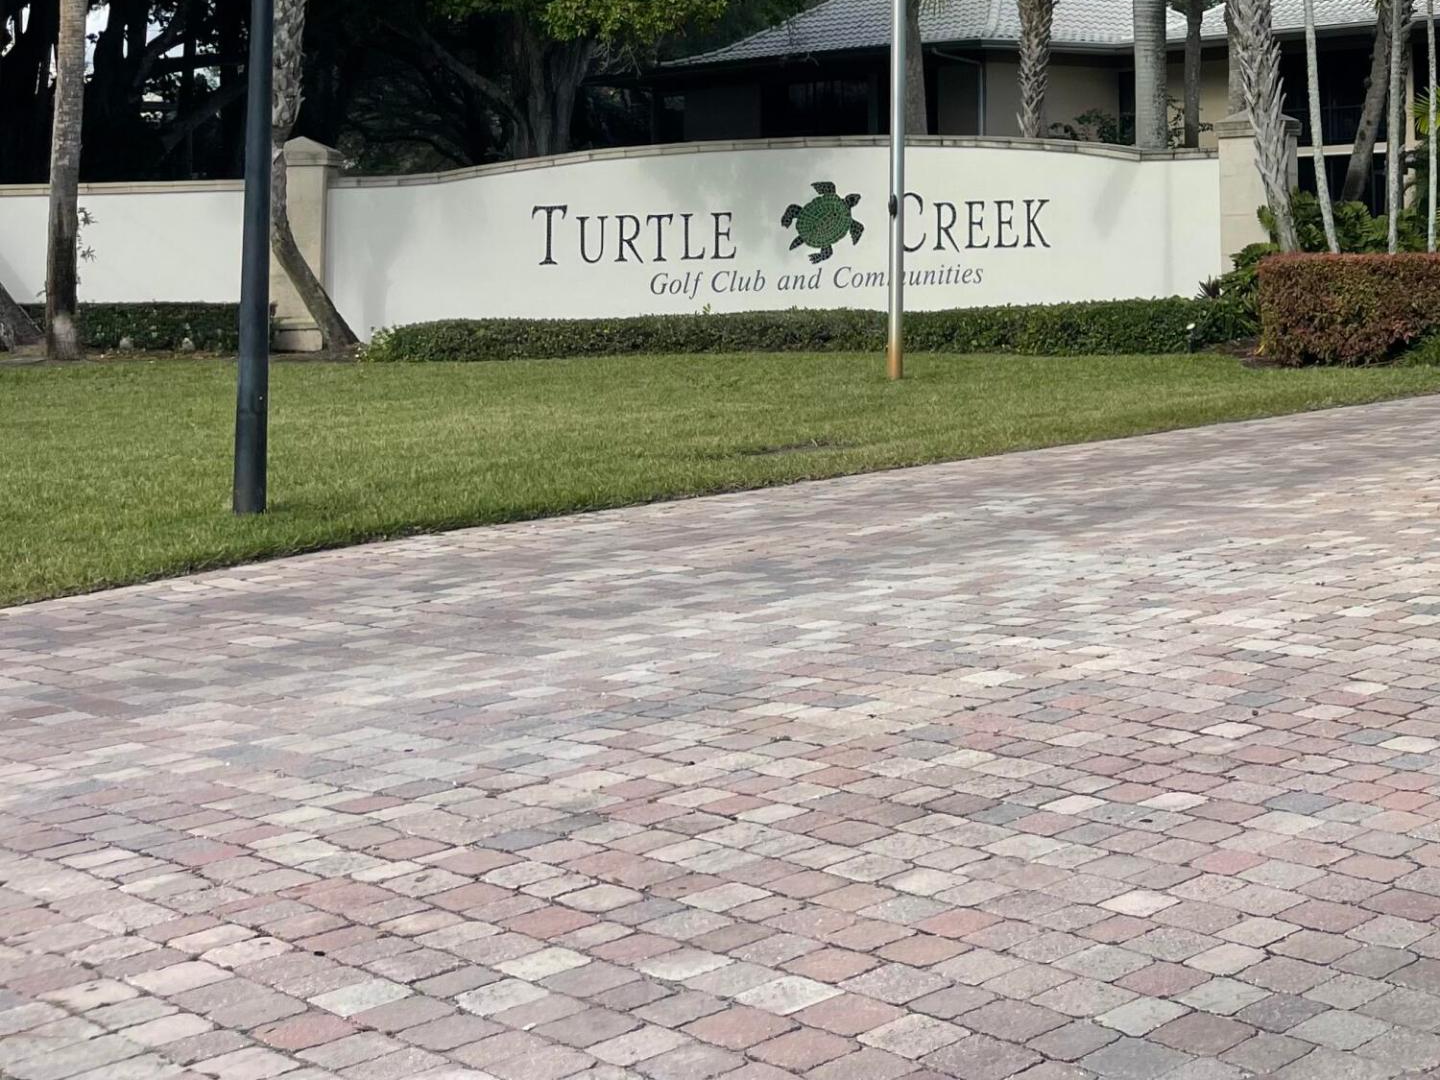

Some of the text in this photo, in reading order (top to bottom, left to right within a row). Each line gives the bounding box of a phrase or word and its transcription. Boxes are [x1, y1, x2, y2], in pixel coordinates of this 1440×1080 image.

[531, 192, 1051, 266] TURTLE CREEK
[650, 271, 703, 300] Golf
[711, 270, 766, 293] Club
[777, 268, 822, 291] and
